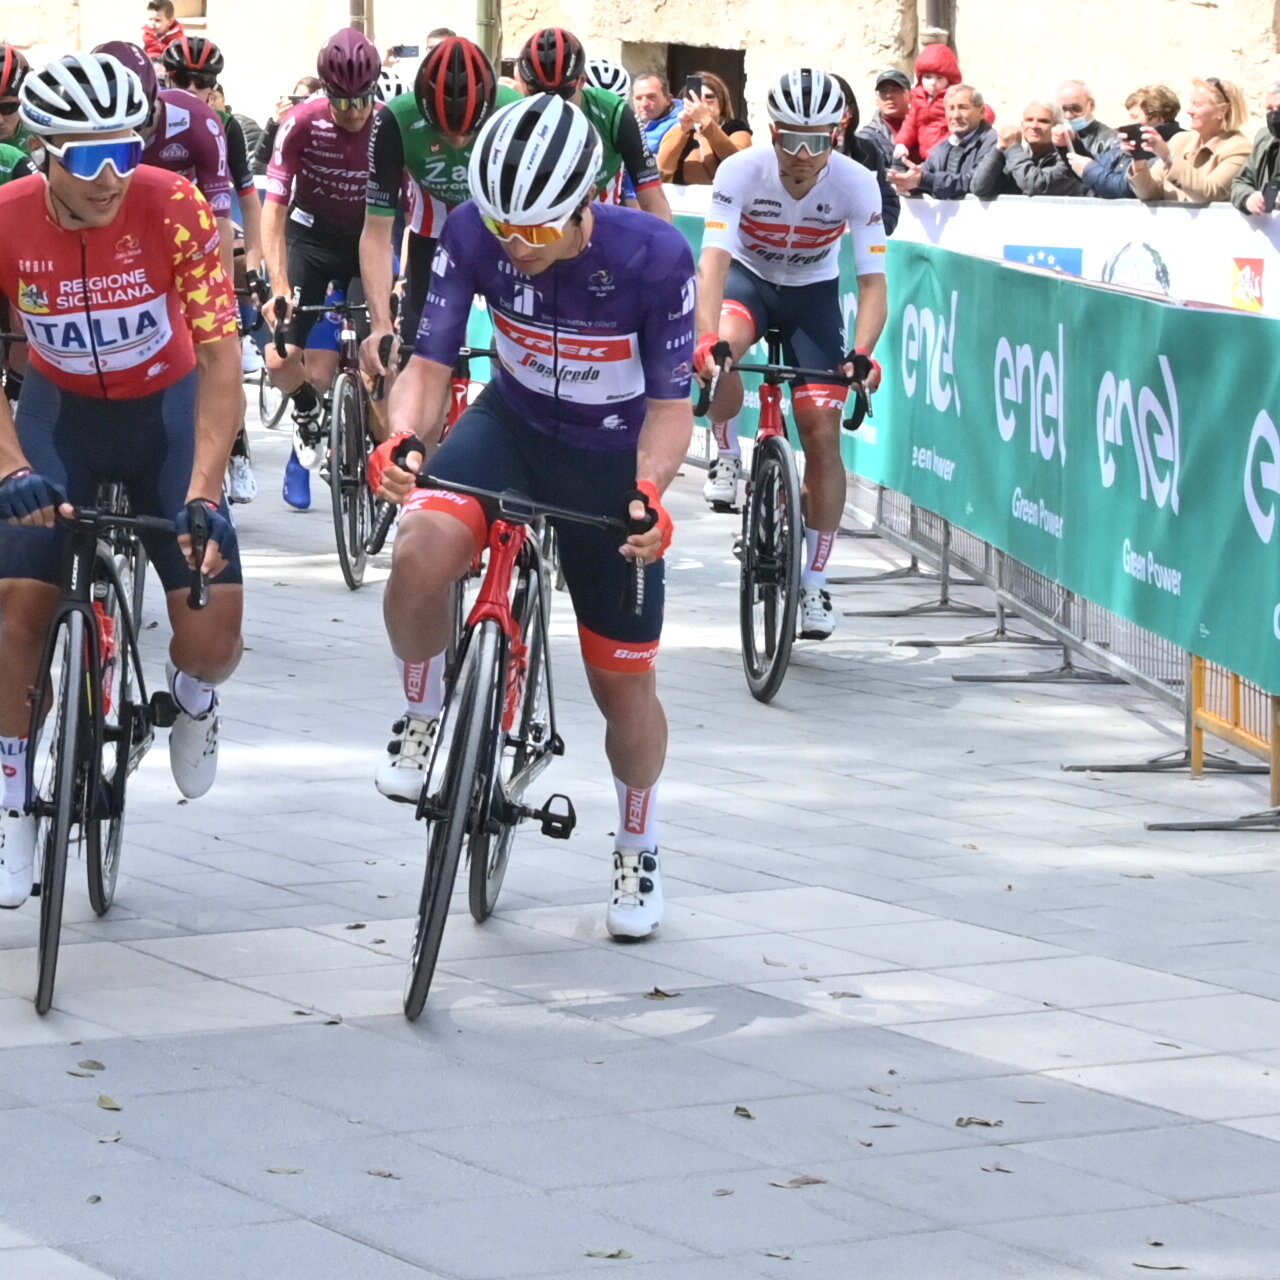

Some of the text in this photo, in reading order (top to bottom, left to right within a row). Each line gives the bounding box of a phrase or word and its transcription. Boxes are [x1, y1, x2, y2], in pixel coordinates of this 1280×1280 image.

[18, 260, 54, 273] GOBIK
[59, 269, 147, 294] REGIONE
[56, 285, 157, 310] SICILIANA
[27, 310, 159, 350] ITALIA
[504, 326, 609, 359] TREK
[517, 352, 601, 382] Segafredo
[993, 322, 1067, 469] enel
[1096, 354, 1180, 517] enel
[1011, 486, 1064, 540] Green Power
[70, 554, 80, 591] LOOK
[1122, 537, 1182, 597] Green Power
[407, 661, 425, 701] TREK
[625, 789, 650, 834] TREK
